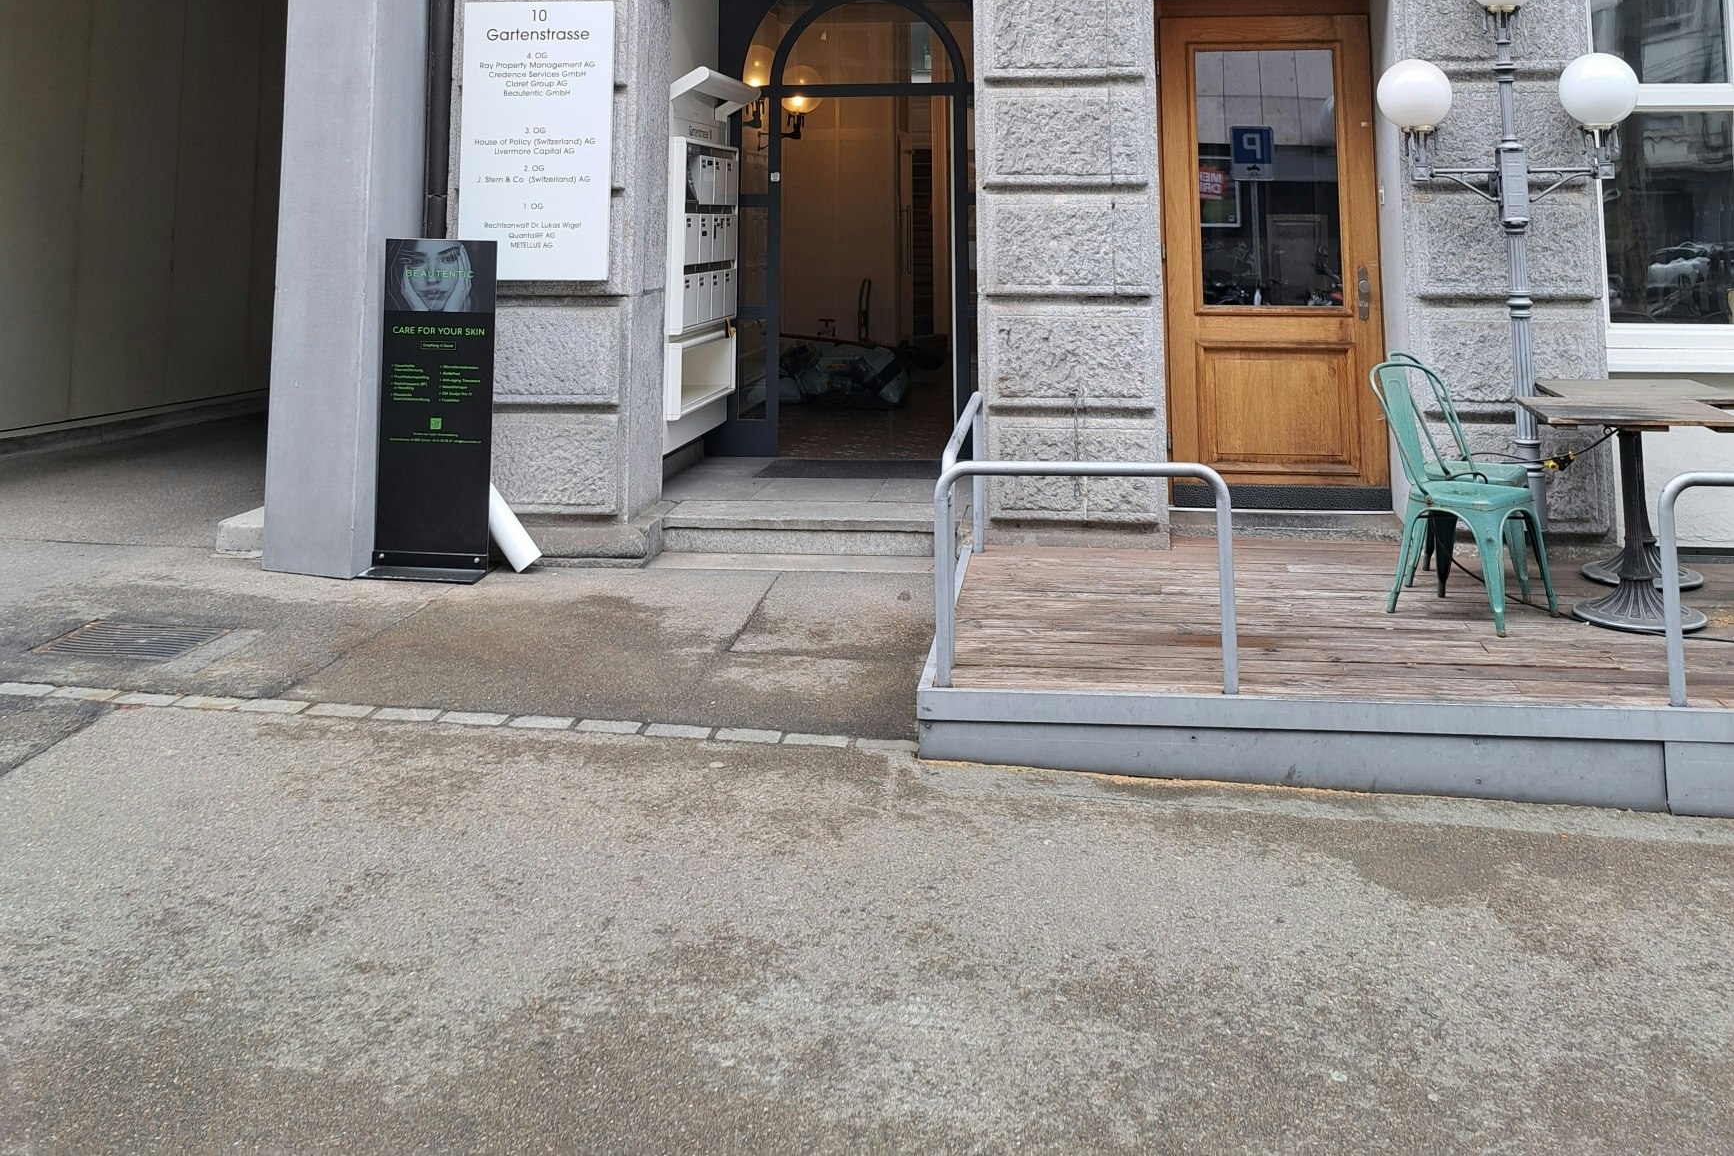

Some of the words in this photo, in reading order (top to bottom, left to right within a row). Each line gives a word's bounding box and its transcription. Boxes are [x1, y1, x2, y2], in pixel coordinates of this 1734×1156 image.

[531, 10, 547, 22] 10
[486, 28, 590, 42] Gartenstrasse
[530, 80, 554, 88] Group
[533, 138, 582, 146] (Switzerland)
[528, 176, 577, 184] (Switzerland)
[405, 269, 474, 279] BEAUTENTIC
[392, 326, 415, 335] CARE
[418, 326, 435, 335] FOR
[438, 327, 463, 336] YOUR
[465, 327, 485, 336] SKIN
